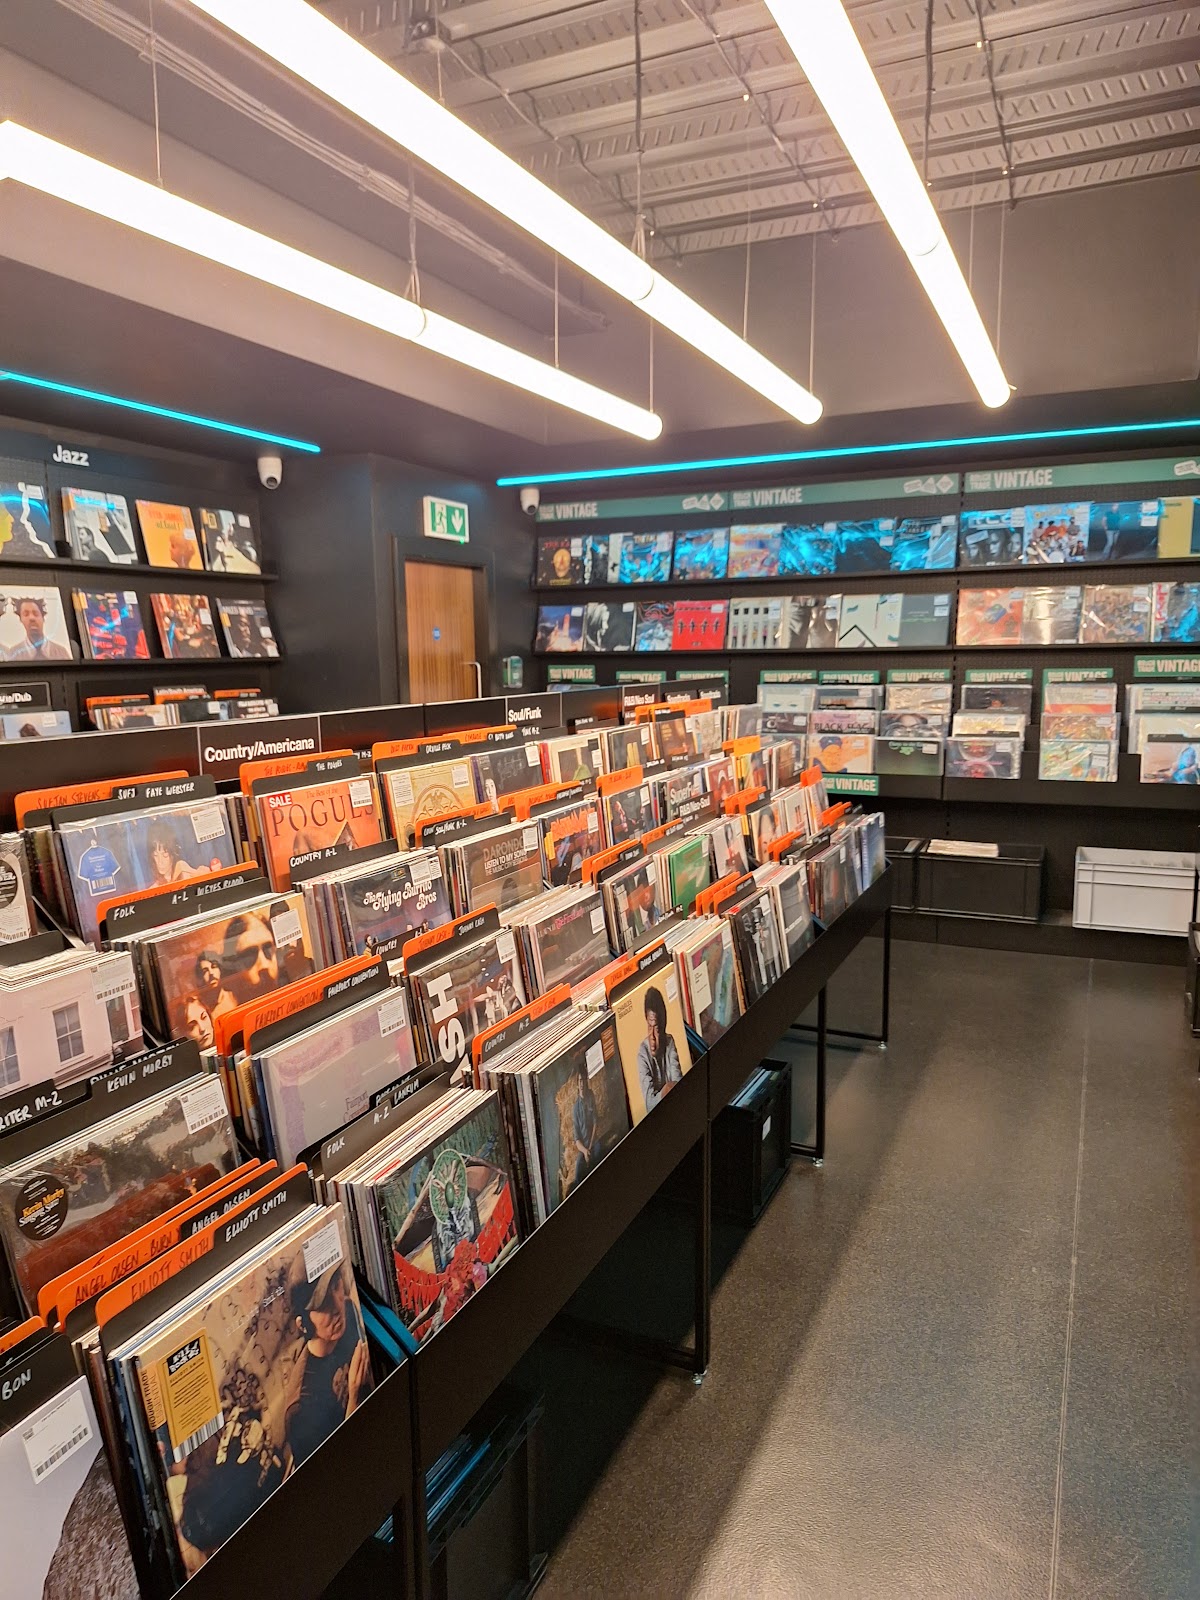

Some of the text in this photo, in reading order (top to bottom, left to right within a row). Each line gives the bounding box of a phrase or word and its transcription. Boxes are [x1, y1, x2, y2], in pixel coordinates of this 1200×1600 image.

[52, 445, 90, 467] Jazz
[994, 469, 1053, 488] VINTAGE
[753, 488, 802, 506] VINTAGE
[556, 502, 598, 519] VINTAGE
[562, 667, 594, 679] VINTAGE
[1156, 659, 1200, 673] VINTAG
[837, 673, 875, 684] VINTAGE
[508, 707, 542, 722] Soul/Funk
[204, 738, 315, 762] Country/Americana
[316, 762, 326, 771] THE
[146, 782, 195, 798] FAYE WEBSTER
[670, 781, 692, 805] SuperF
[836, 776, 876, 791] VINTAGE
[71, 790, 100, 805] STEVENS
[269, 794, 292, 808] SALE
[290, 847, 337, 868] COUNTRY A-L
[485, 856, 500, 869] LISTEN
[114, 893, 188, 921] FOLK A-L
[373, 889, 402, 912] Flying
[417, 891, 437, 910] Bros
[375, 939, 398, 955] COUNTRY
[327, 966, 380, 999] FAIRPORT CONVENTION
[485, 1031, 506, 1053] COUNTRY
[107, 1070, 136, 1093] KEVIN
[142, 1053, 173, 1077] MORBY
[34, 1091, 63, 1111] M-Z
[393, 1078, 420, 1106] LANKUM
[326, 1136, 346, 1159] FOLK
[22, 1188, 65, 1217] Kevin Morby
[191, 1188, 251, 1236] ANGEL OLSEN
[225, 1190, 288, 1243] ELLIOTT SMITH
[74, 1278, 107, 1307] ANGEL
[110, 1254, 140, 1282] OLSEN
[150, 1233, 173, 1258] BURN
[130, 1236, 210, 1303] ELLIOTT SMITH
[1, 1368, 32, 1400] BON
[141, 1368, 151, 1397] TRADE
